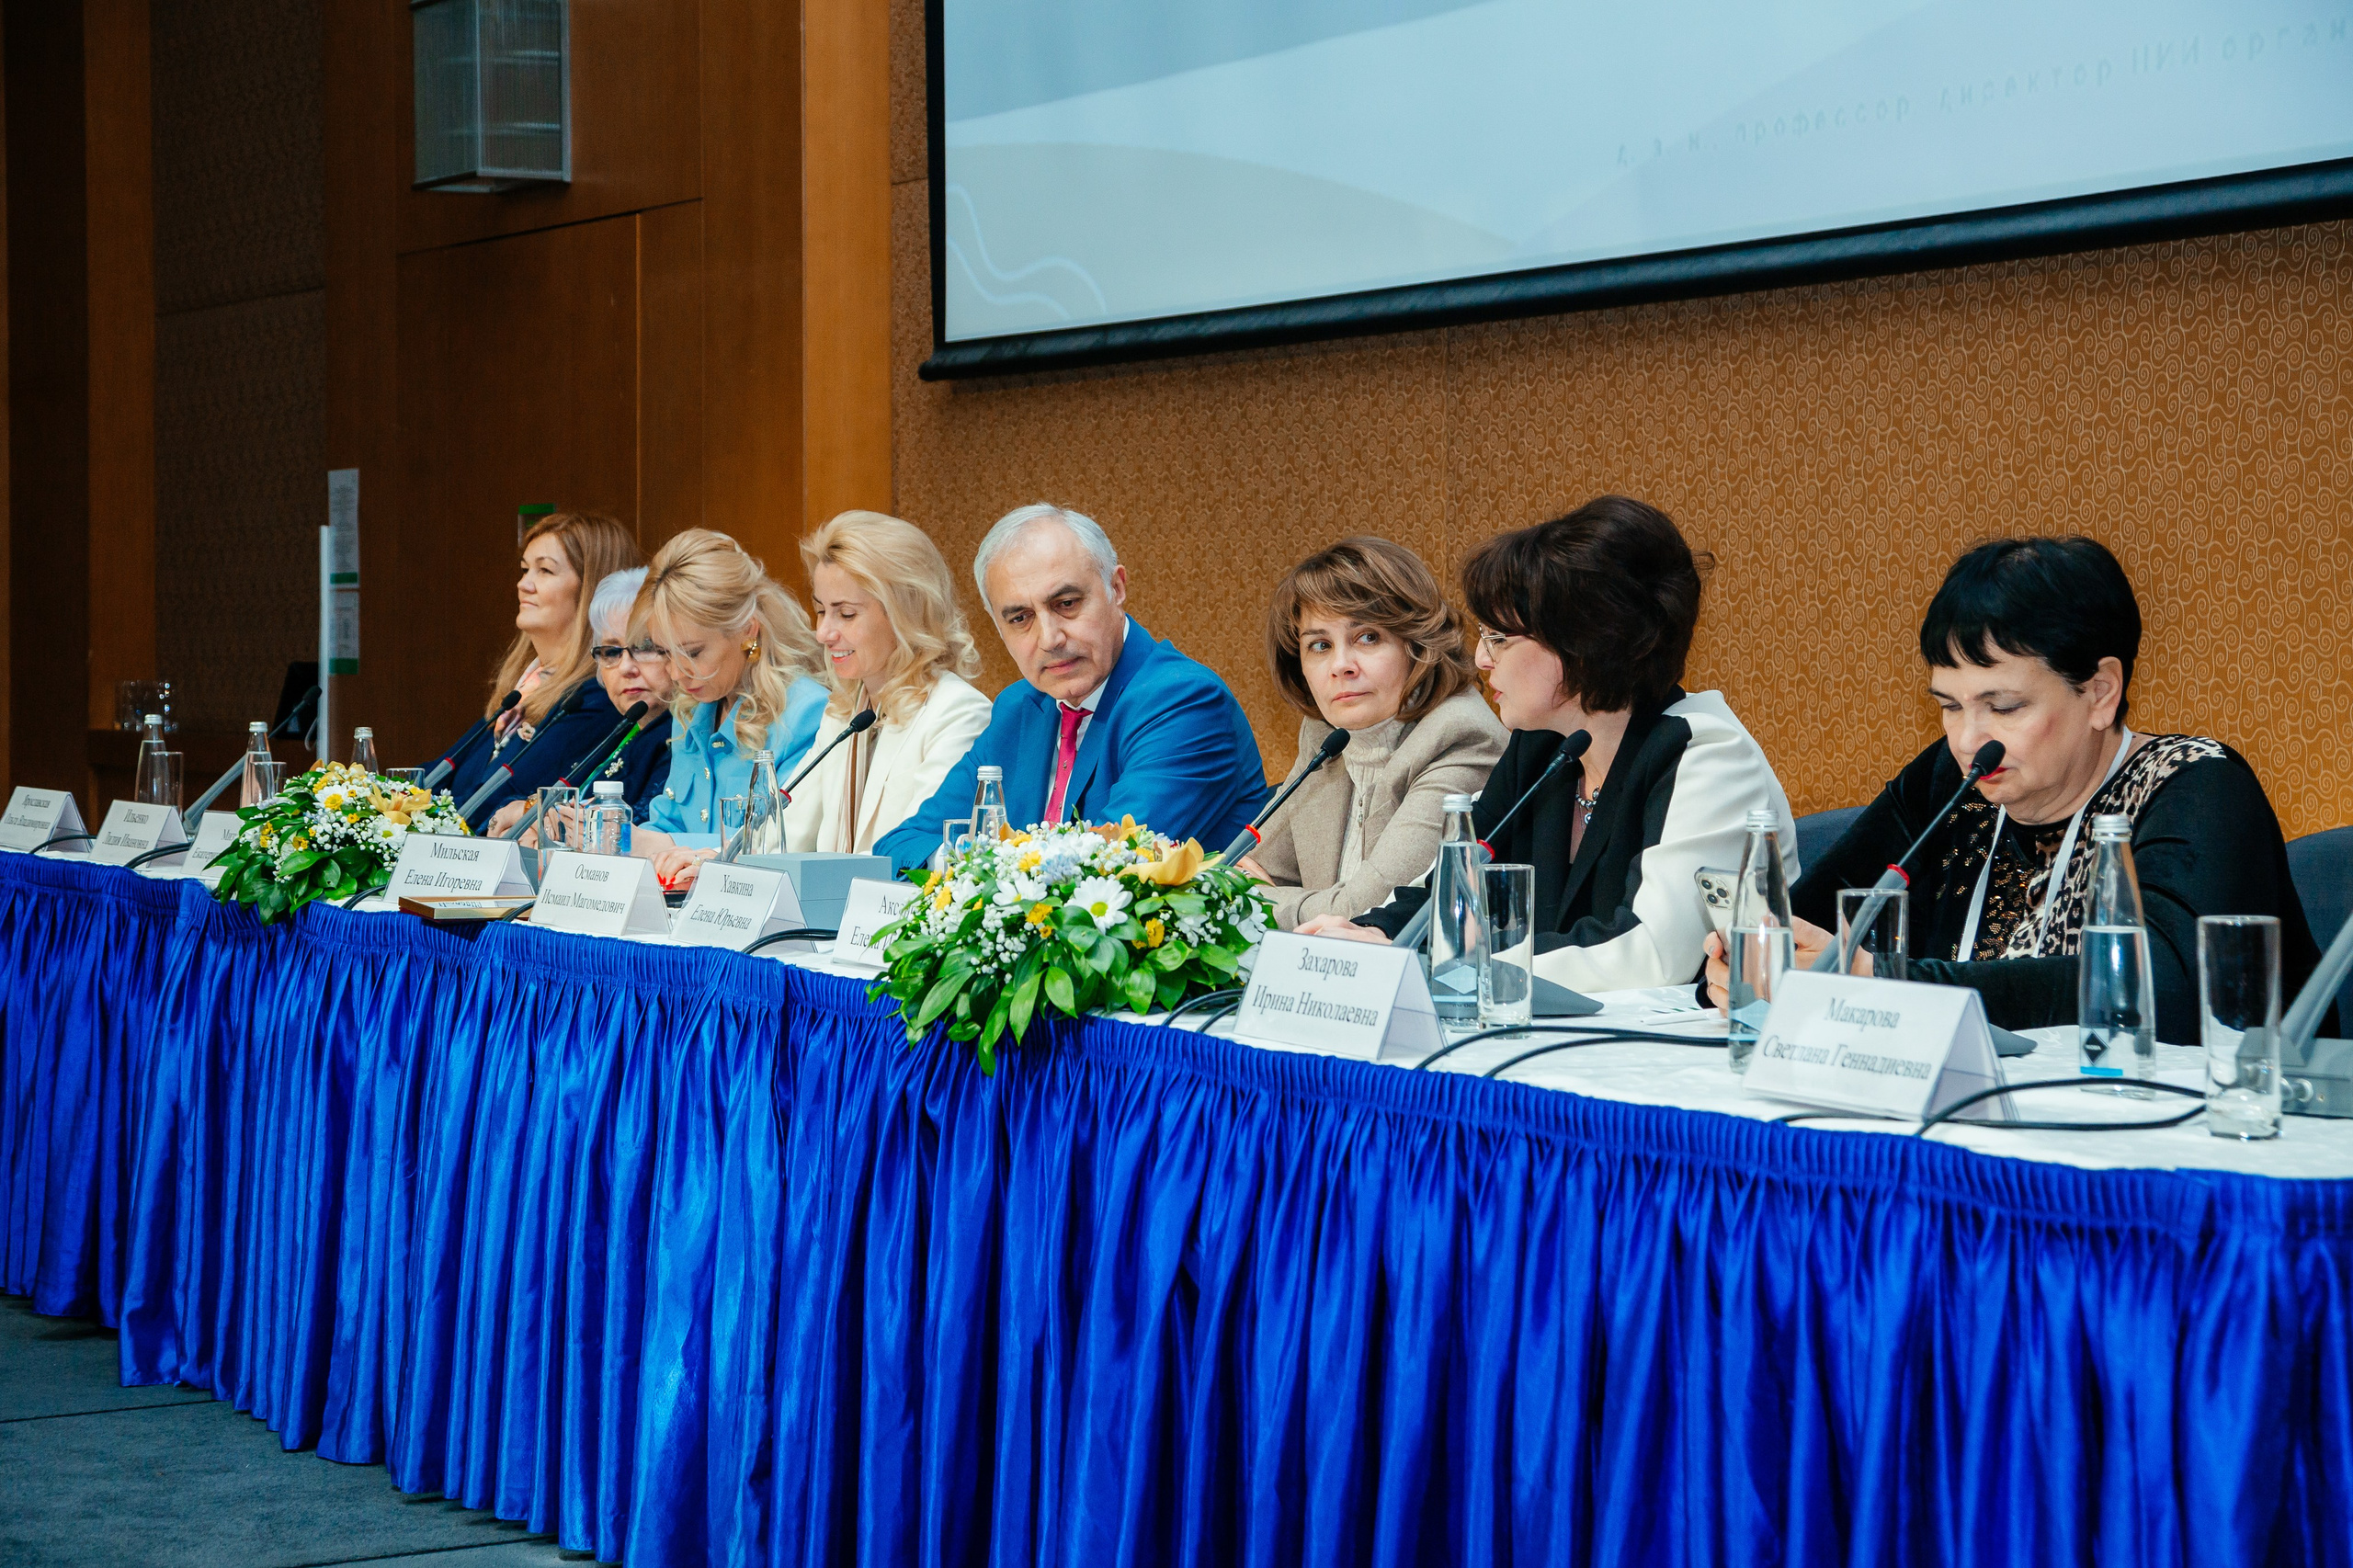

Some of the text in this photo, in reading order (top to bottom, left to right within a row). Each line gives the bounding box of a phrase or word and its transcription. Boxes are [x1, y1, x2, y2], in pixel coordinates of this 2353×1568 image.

[430, 842, 480, 862] Мильская
[404, 869, 483, 892] Елена Игоревна
[574, 864, 609, 881] Османов
[721, 874, 754, 897] Хавкина
[541, 889, 625, 914] Исмаил Магомедович
[690, 904, 753, 931] Елена Юрьевна
[1297, 948, 1358, 981] Захарова
[1252, 984, 1379, 1027] Ирина Николаевна
[1824, 997, 1901, 1031] Макарова
[1763, 1035, 1932, 1080] Светлана Геннадиевна
